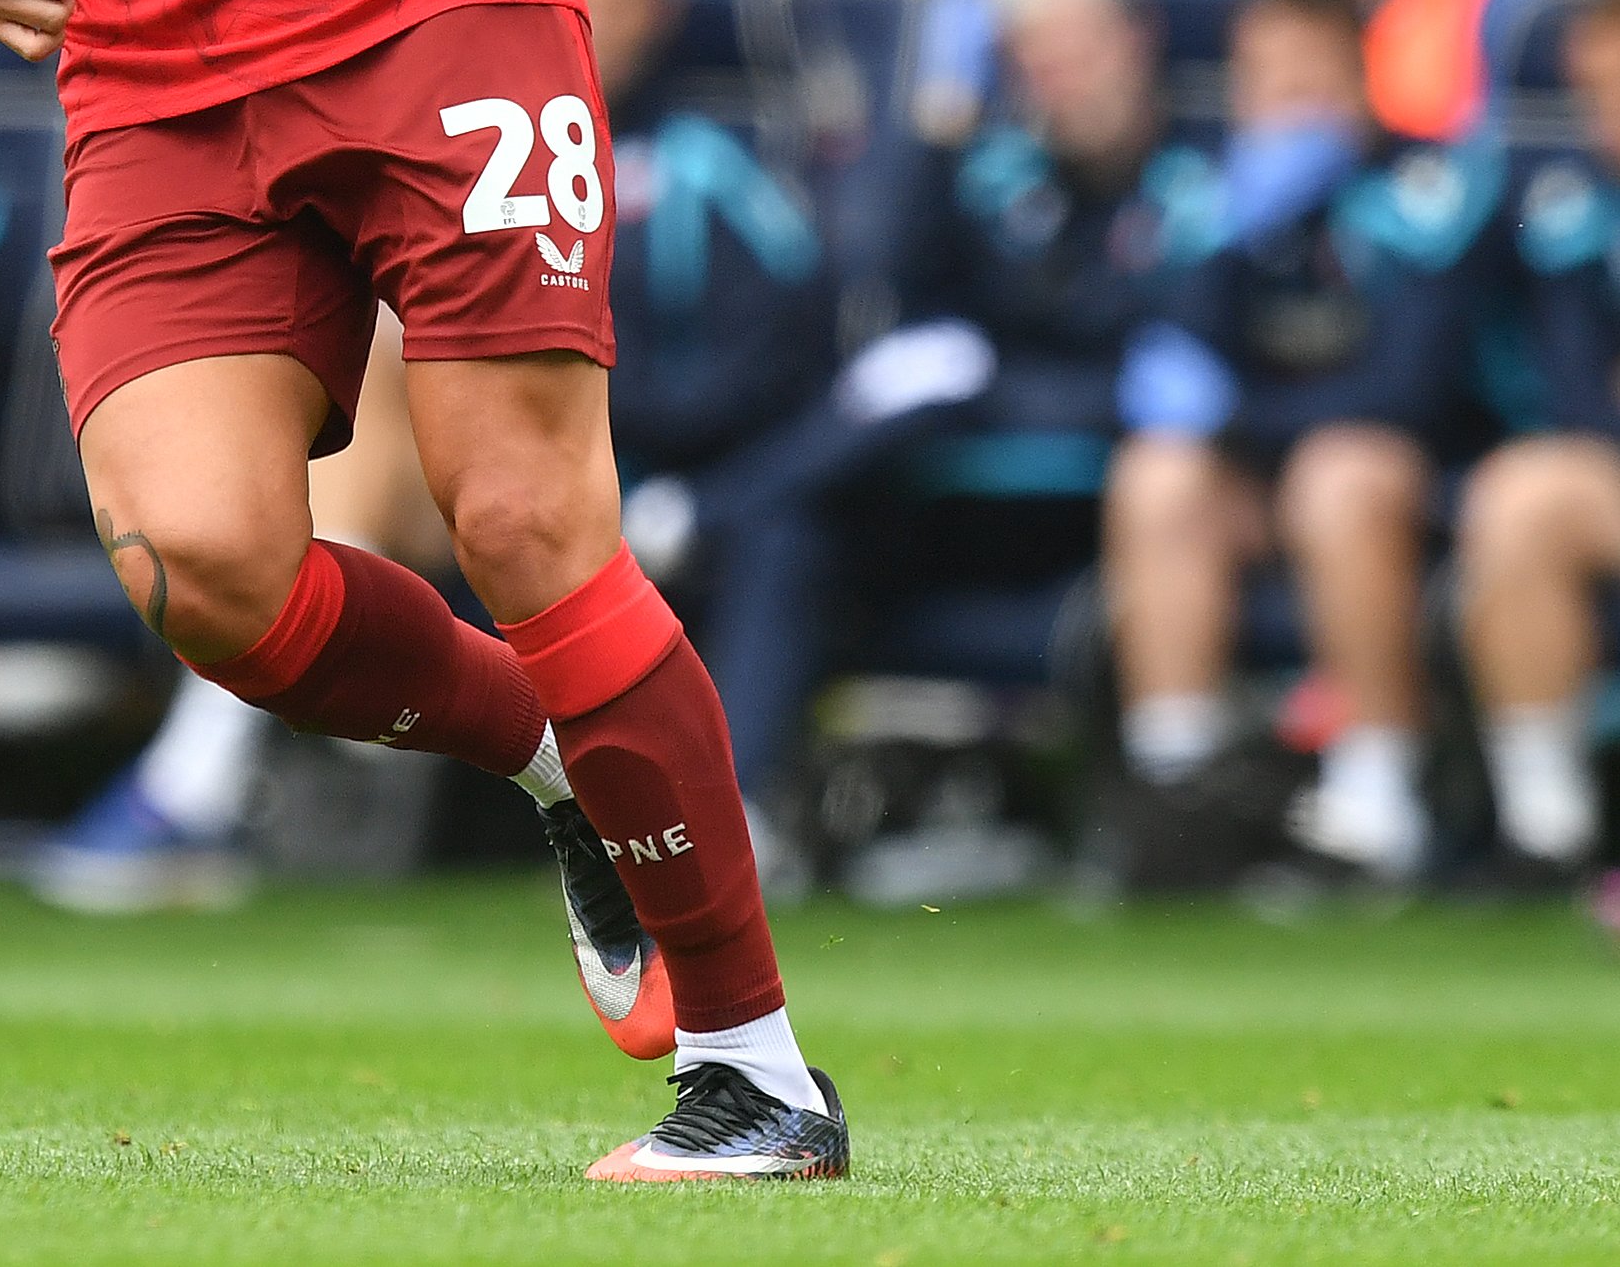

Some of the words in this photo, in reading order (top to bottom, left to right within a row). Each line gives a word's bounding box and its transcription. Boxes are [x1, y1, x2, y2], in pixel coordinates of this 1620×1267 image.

[439, 94, 604, 233] 28
[540, 274, 589, 291] CASTORE
[601, 822, 694, 865] PNE
